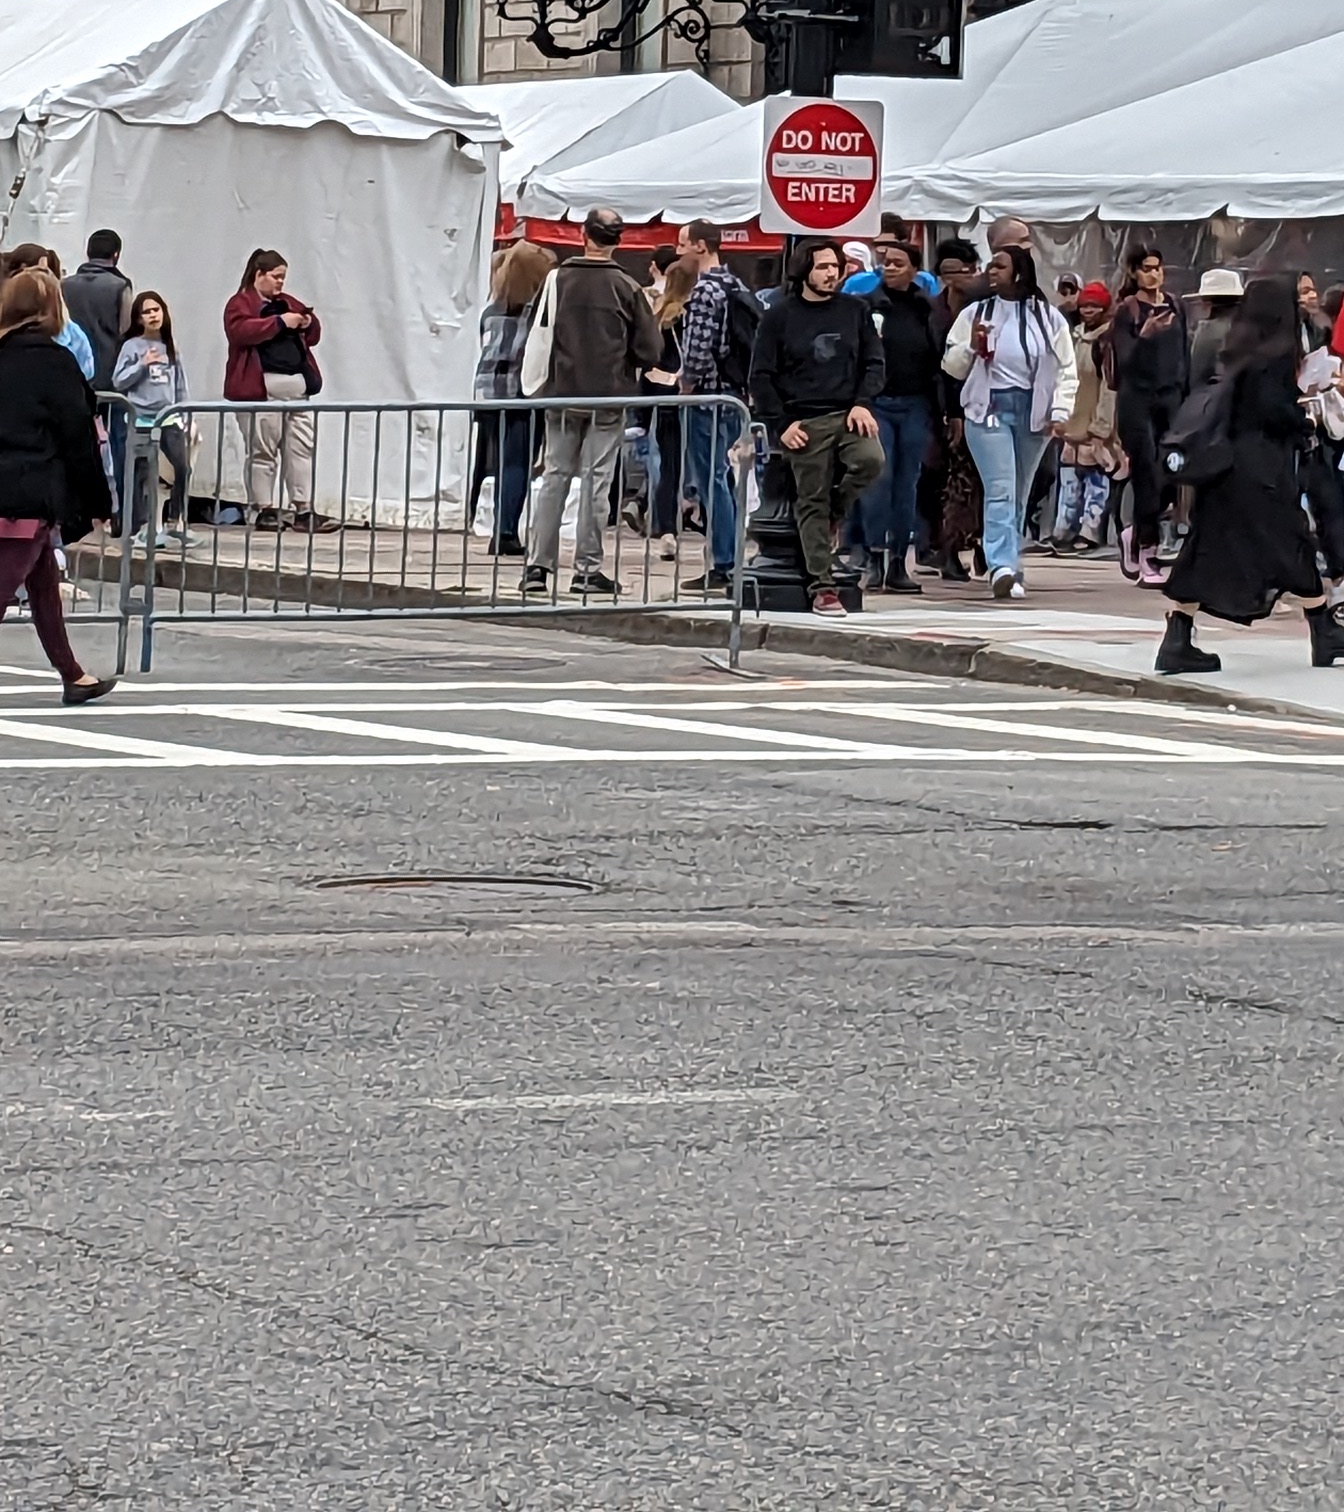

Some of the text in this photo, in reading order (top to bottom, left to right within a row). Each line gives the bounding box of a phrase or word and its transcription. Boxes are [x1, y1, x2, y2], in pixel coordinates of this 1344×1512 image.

[782, 130, 864, 152] DO NOT
[787, 182, 856, 203] ENTER
